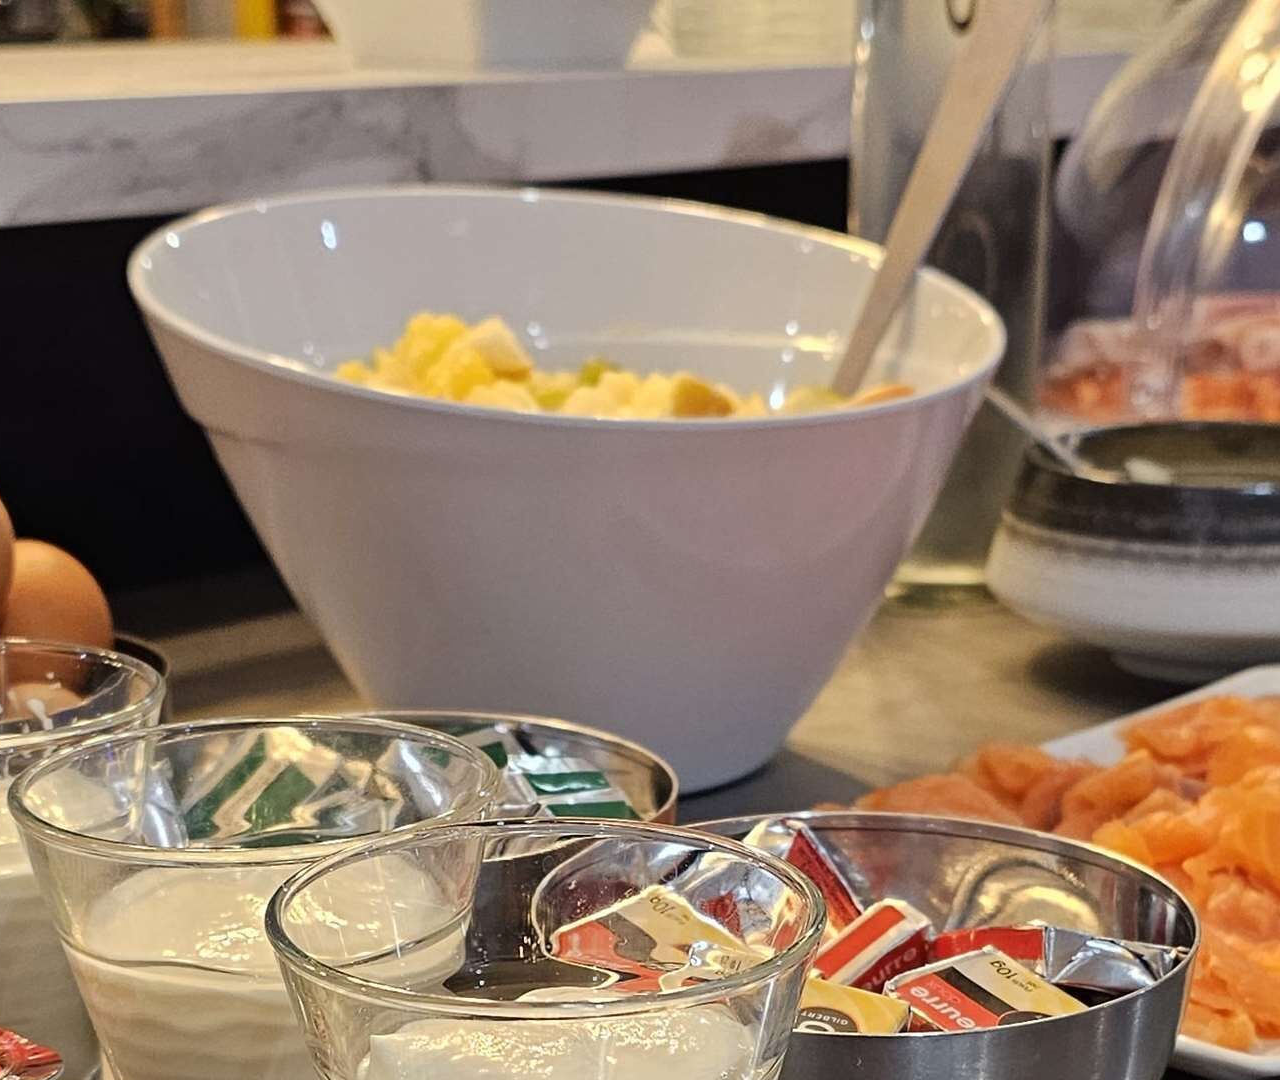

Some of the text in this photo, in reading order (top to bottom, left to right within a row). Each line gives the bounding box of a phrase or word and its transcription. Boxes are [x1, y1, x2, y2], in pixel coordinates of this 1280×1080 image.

[989, 959, 1019, 980] 10g
[800, 1010, 849, 1026] GILBERT
[909, 985, 978, 1030] eurre
